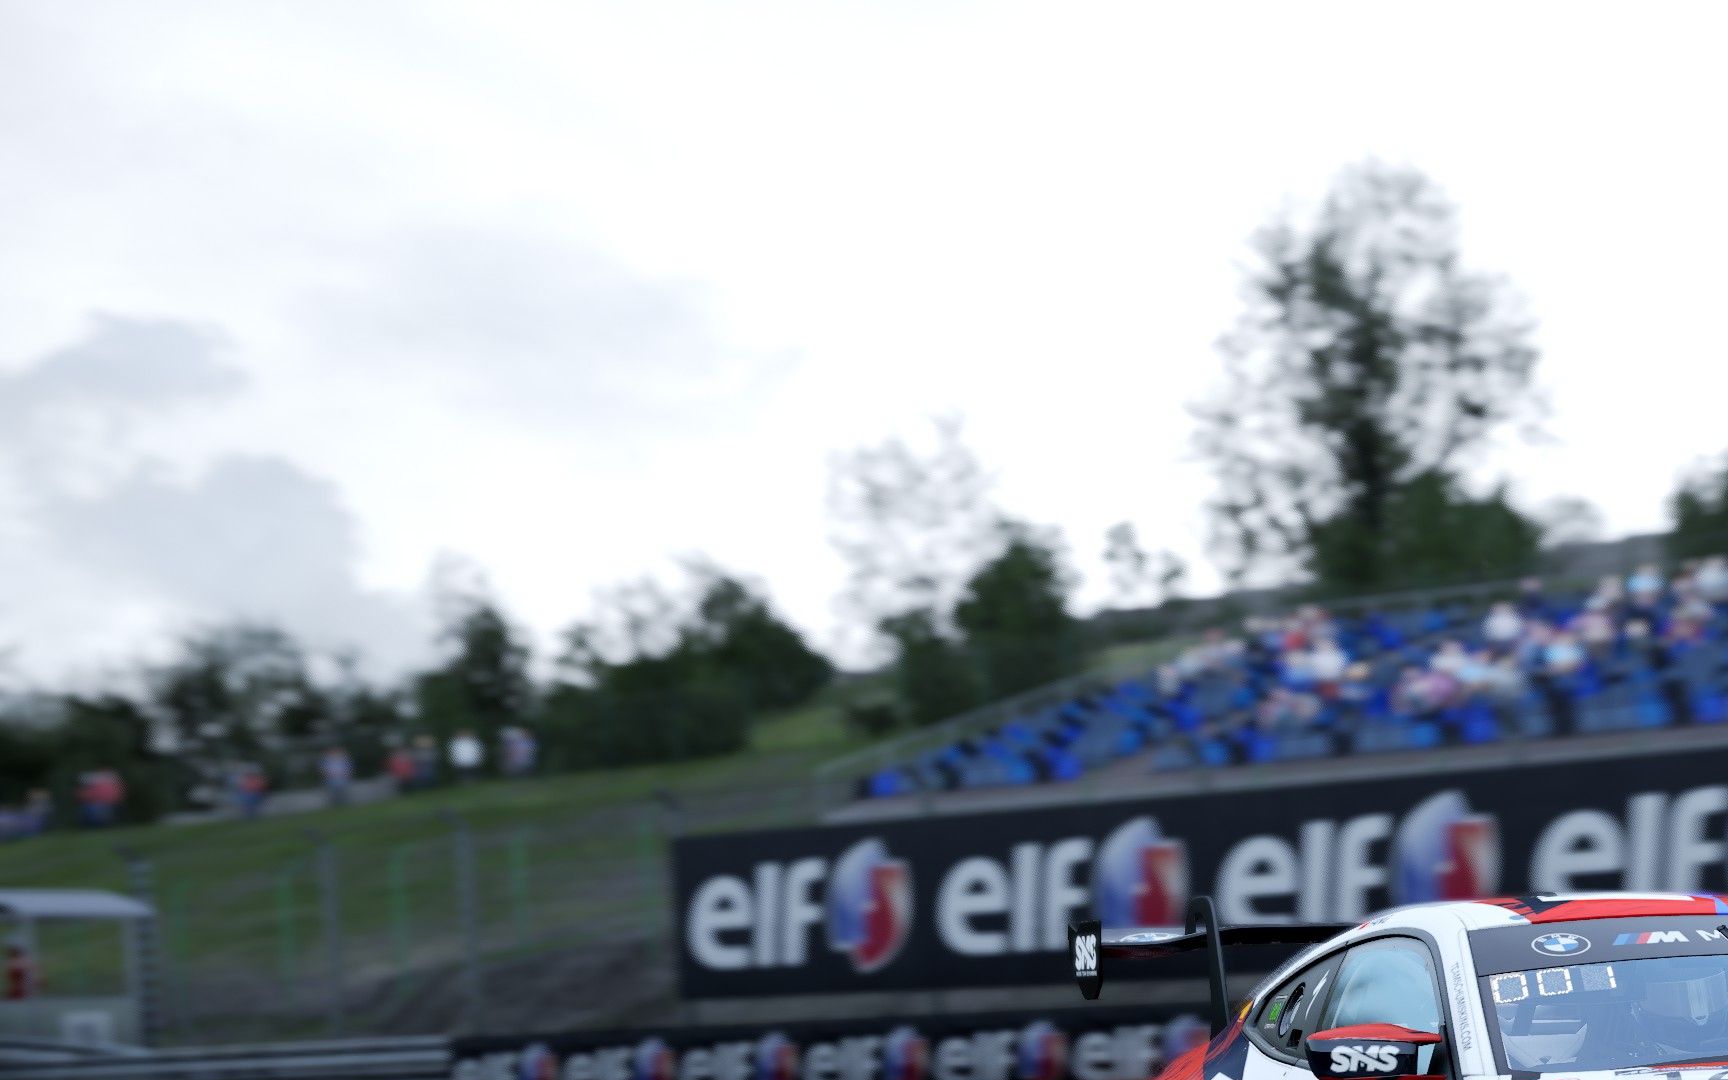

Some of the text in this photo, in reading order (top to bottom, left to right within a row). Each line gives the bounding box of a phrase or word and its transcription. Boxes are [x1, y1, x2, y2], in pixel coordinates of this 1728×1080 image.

[686, 860, 828, 970] elf
[934, 839, 1098, 956] elf
[1217, 813, 1392, 925] elf
[1330, 1045, 1400, 1073] SMS
